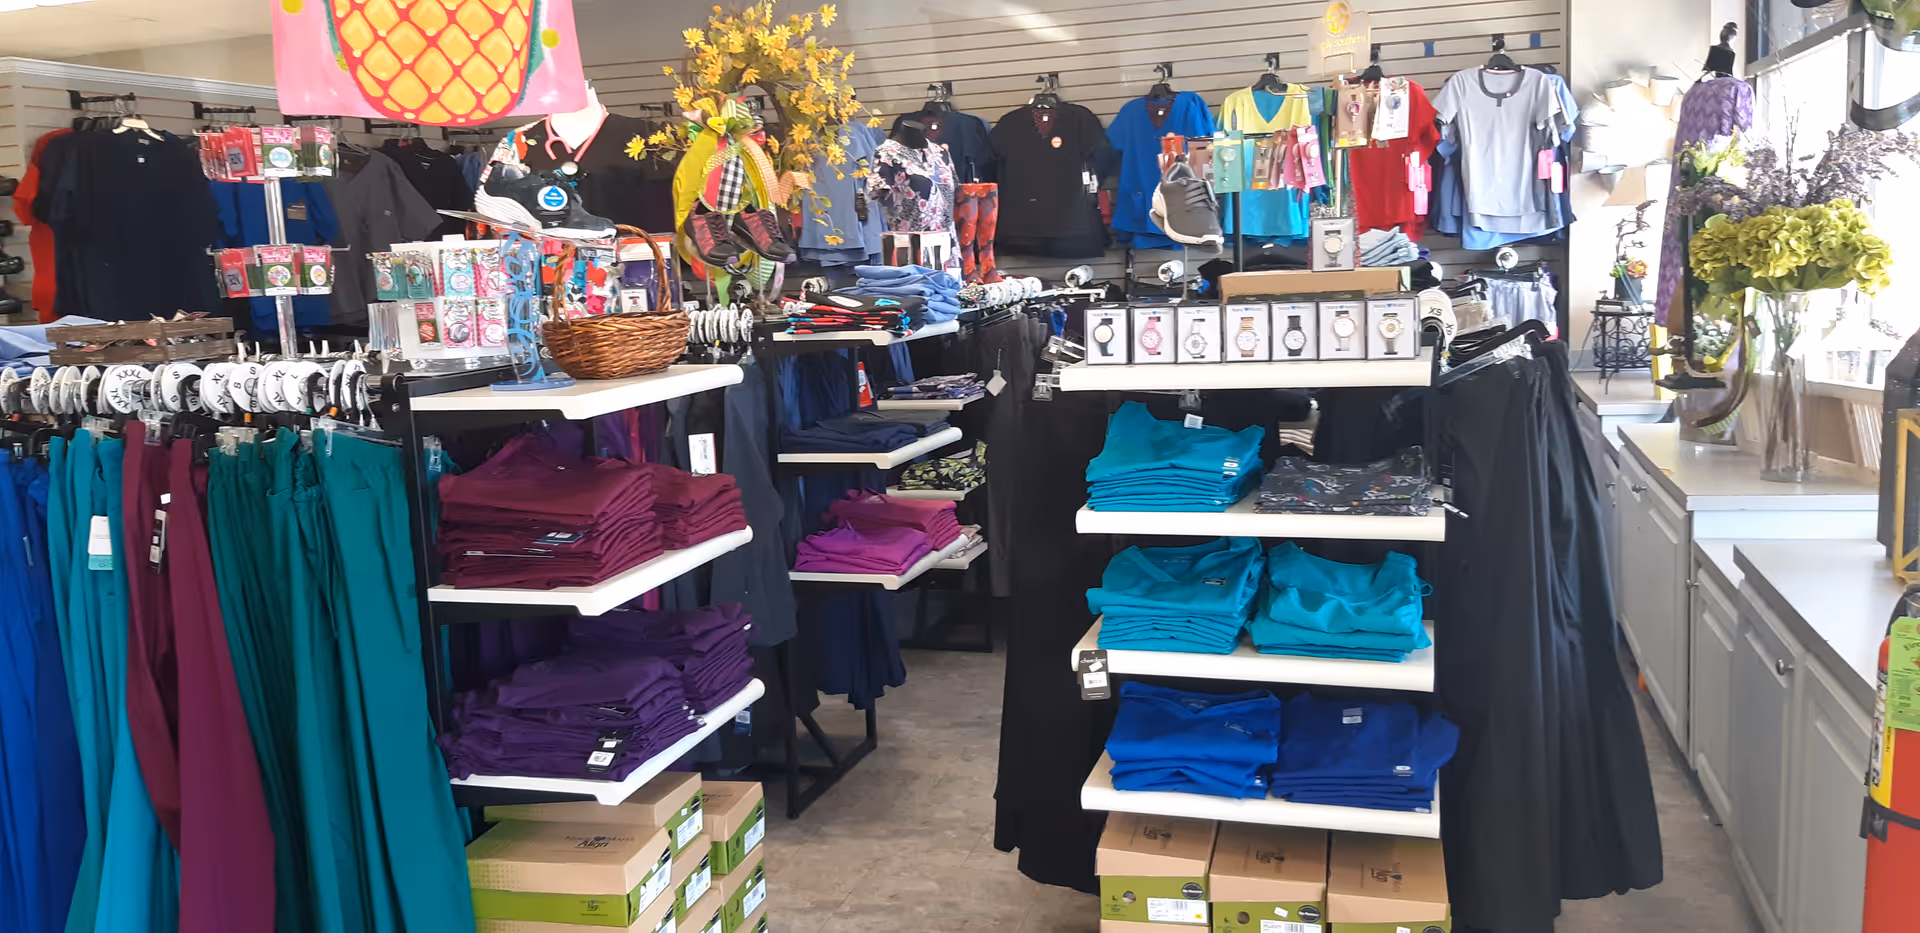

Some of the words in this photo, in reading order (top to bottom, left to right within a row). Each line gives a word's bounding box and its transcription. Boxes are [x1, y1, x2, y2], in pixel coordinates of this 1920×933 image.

[1427, 306, 1443, 317] XS
[116, 368, 143, 381] XXXL
[172, 370, 181, 380] S
[249, 365, 257, 376] S
[271, 368, 287, 382] XL
[211, 371, 226, 385] XL
[272, 391, 286, 406] XL
